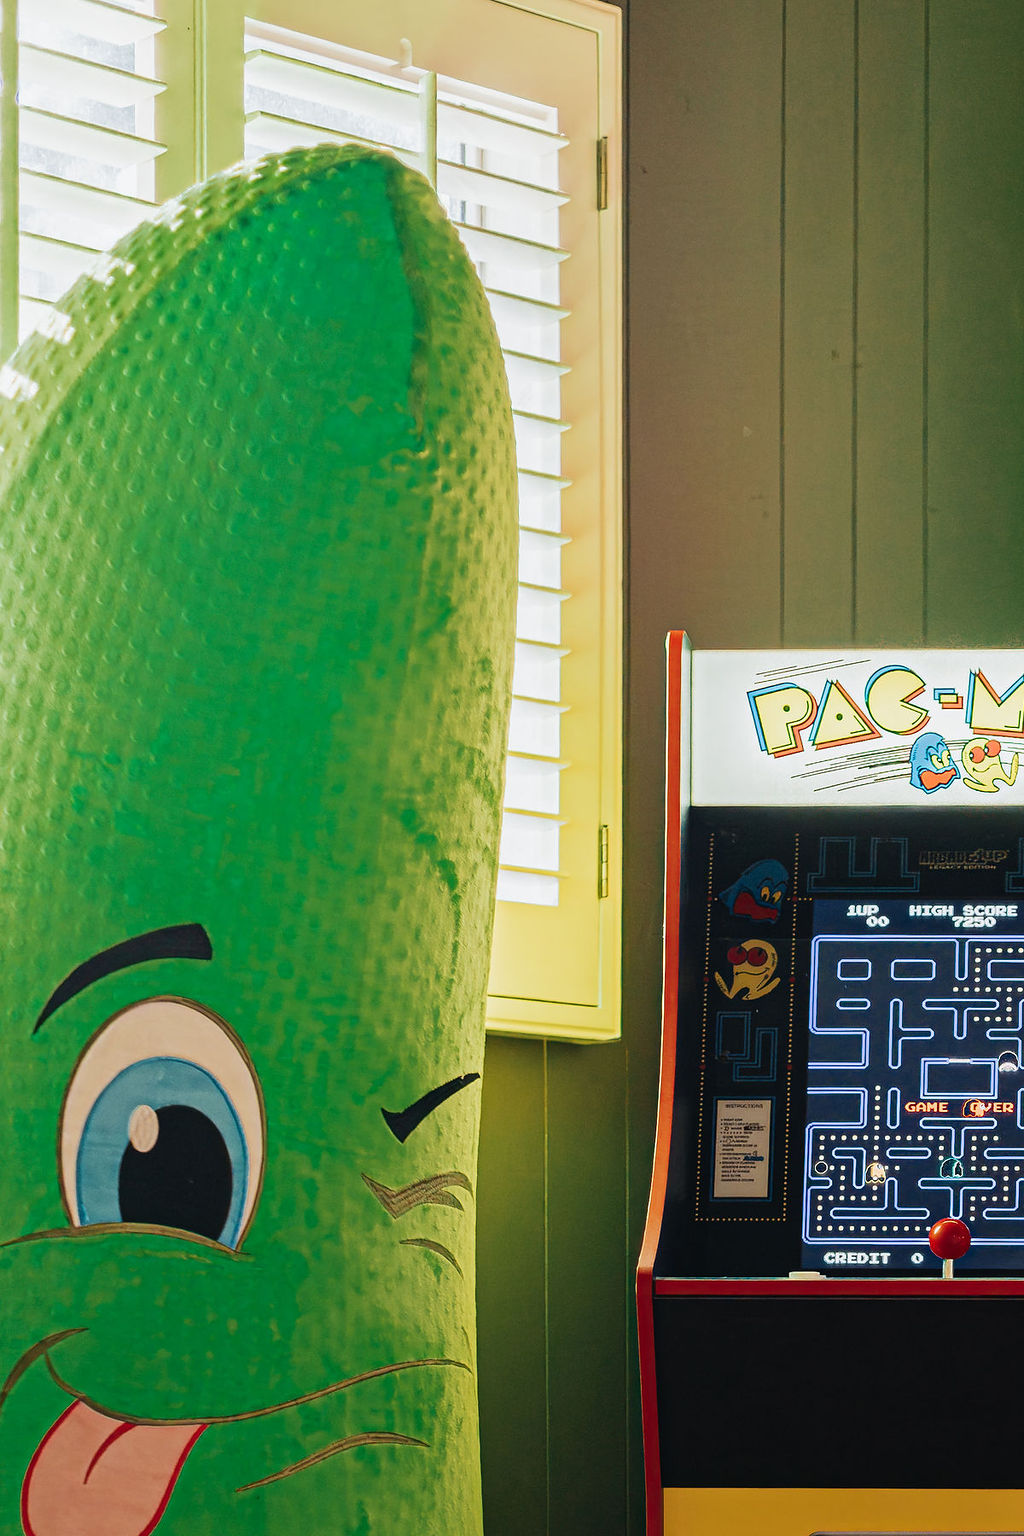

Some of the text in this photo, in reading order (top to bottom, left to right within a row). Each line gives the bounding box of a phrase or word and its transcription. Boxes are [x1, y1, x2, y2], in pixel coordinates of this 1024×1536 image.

[846, 904, 880, 917] 1UP
[908, 904, 1019, 917] HIGH SCORE
[865, 916, 891, 928] 00
[951, 916, 997, 928] 7250
[904, 1101, 1015, 1113] GAME OVER
[822, 1251, 924, 1265] CREDIT 0
